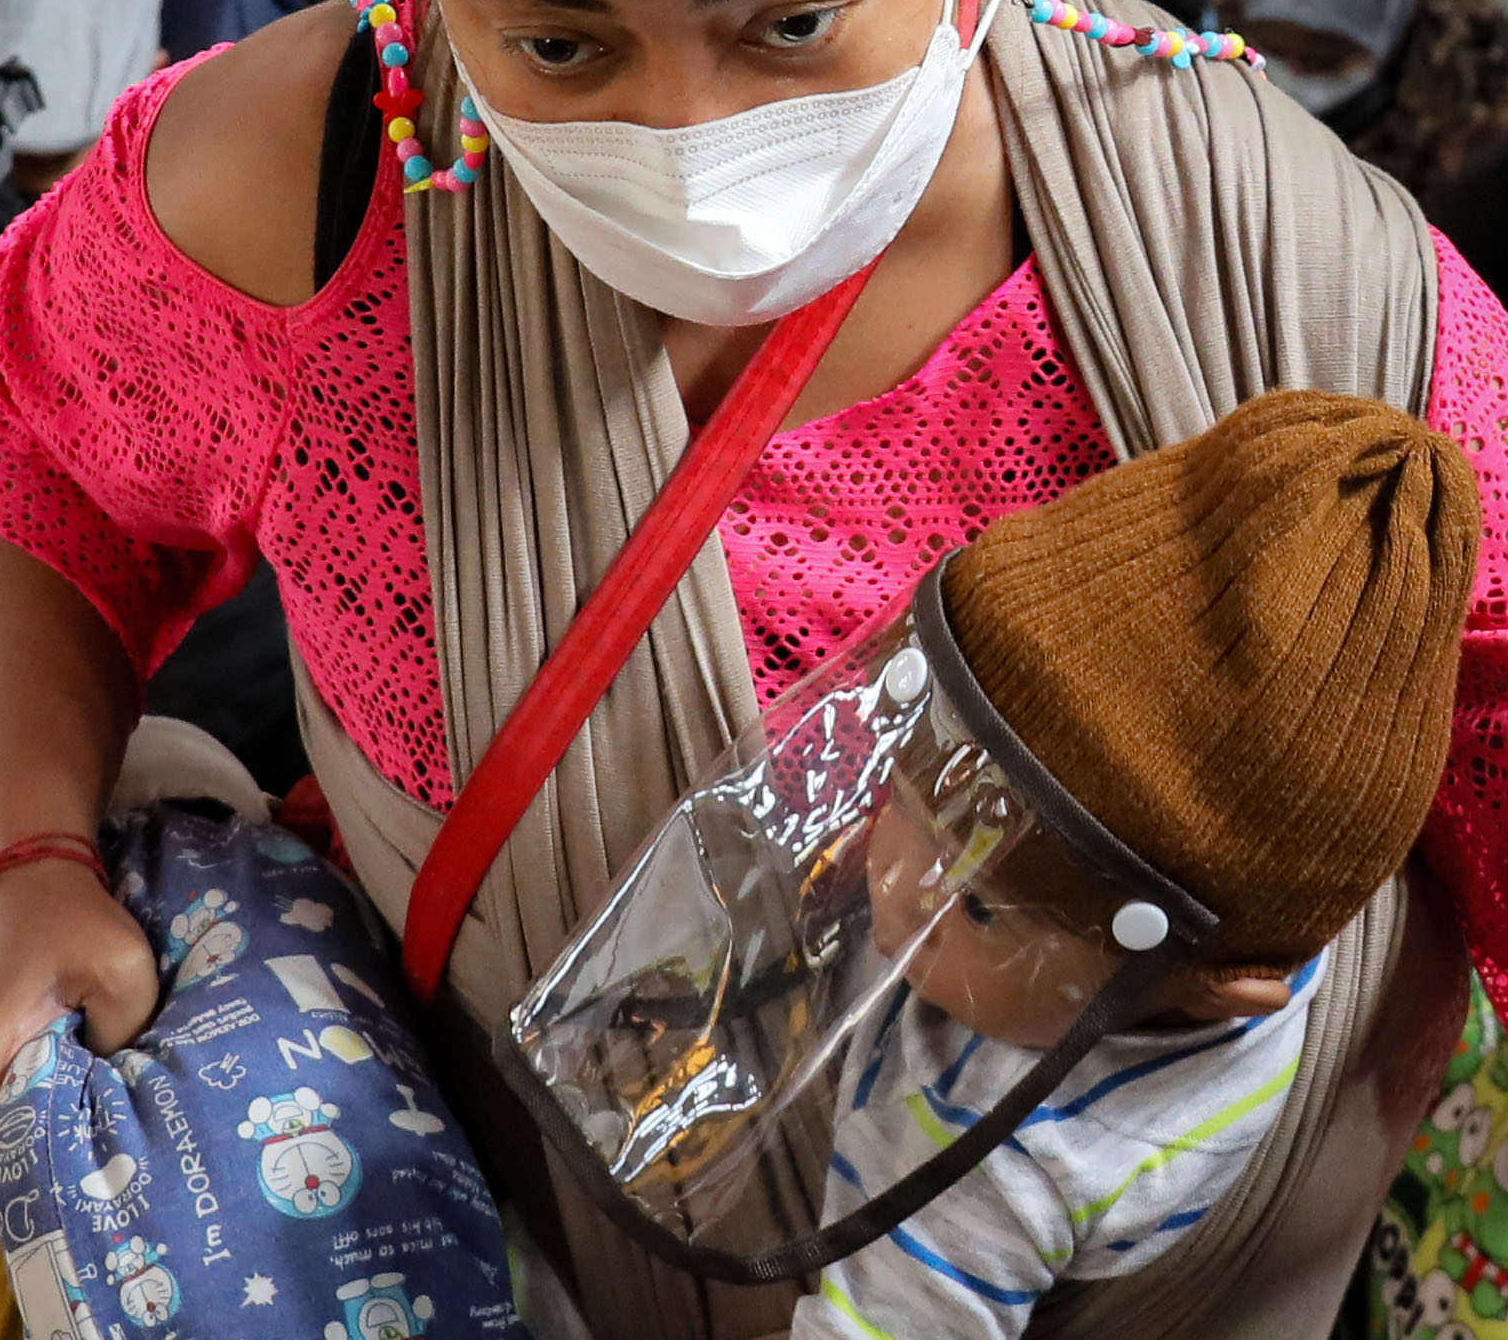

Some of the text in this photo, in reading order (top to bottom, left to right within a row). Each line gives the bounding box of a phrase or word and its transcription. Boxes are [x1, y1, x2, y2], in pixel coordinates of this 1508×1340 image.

[150, 1073, 219, 1218] DORAEMON
[74, 1173, 152, 1212] DORAYAKI
[91, 1194, 150, 1233] I LOVE
[201, 1221, 232, 1266] I'm
